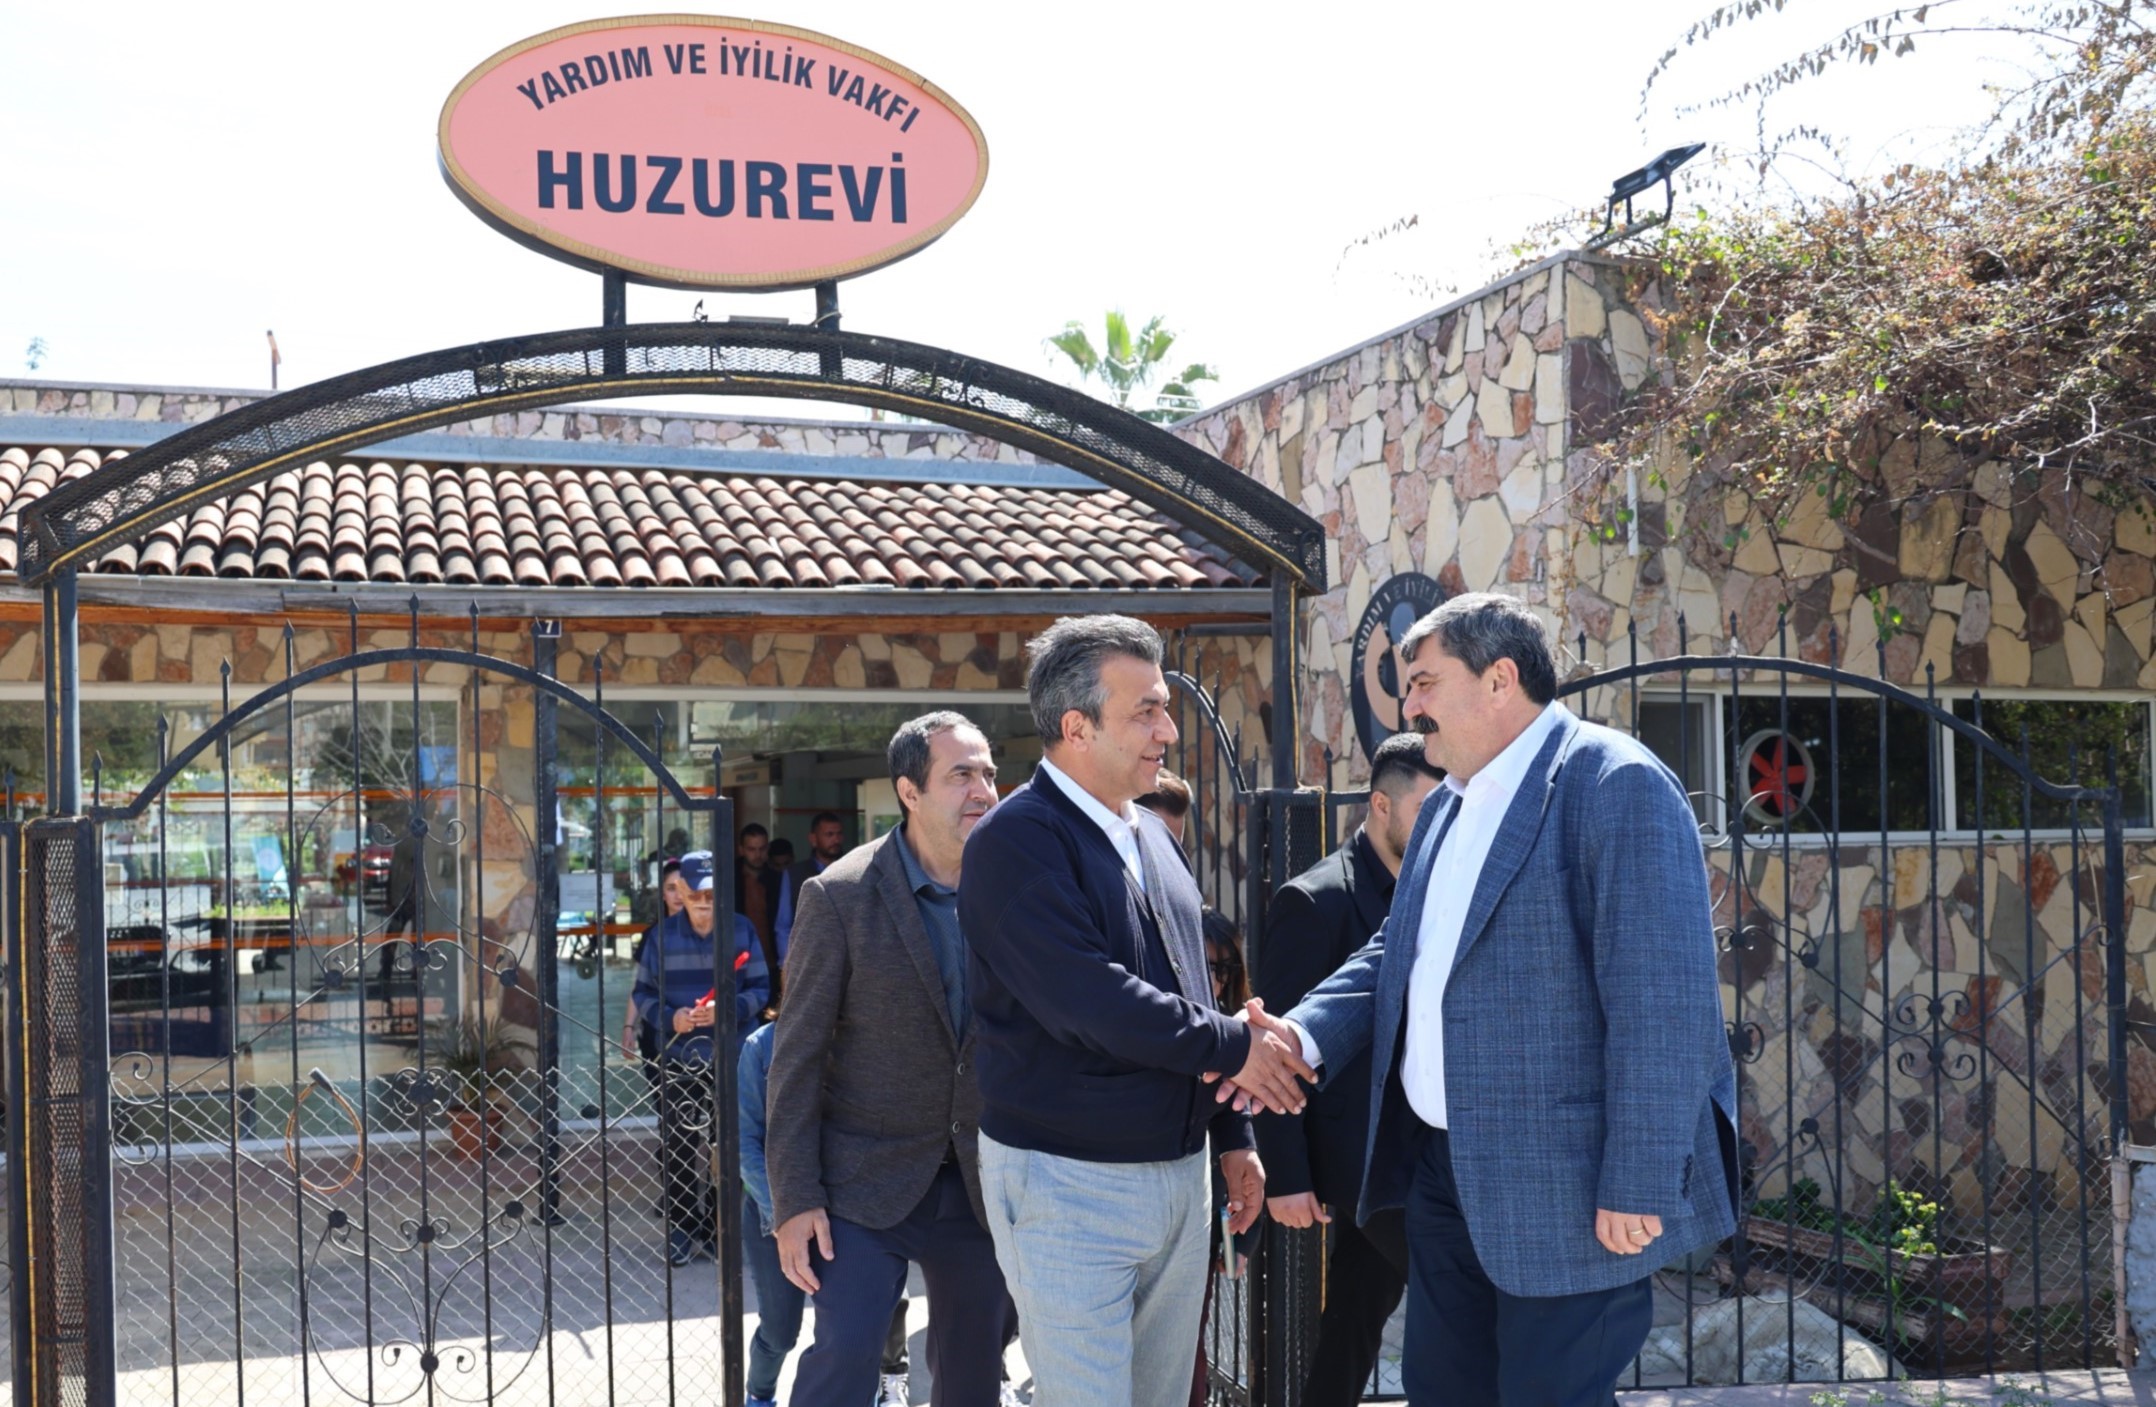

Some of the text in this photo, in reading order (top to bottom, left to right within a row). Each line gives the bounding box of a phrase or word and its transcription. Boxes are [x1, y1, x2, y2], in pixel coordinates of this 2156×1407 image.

[516, 36, 920, 133] YARDIM VE İYİLİK VAKFI
[537, 149, 907, 224] HUZUREVİ
